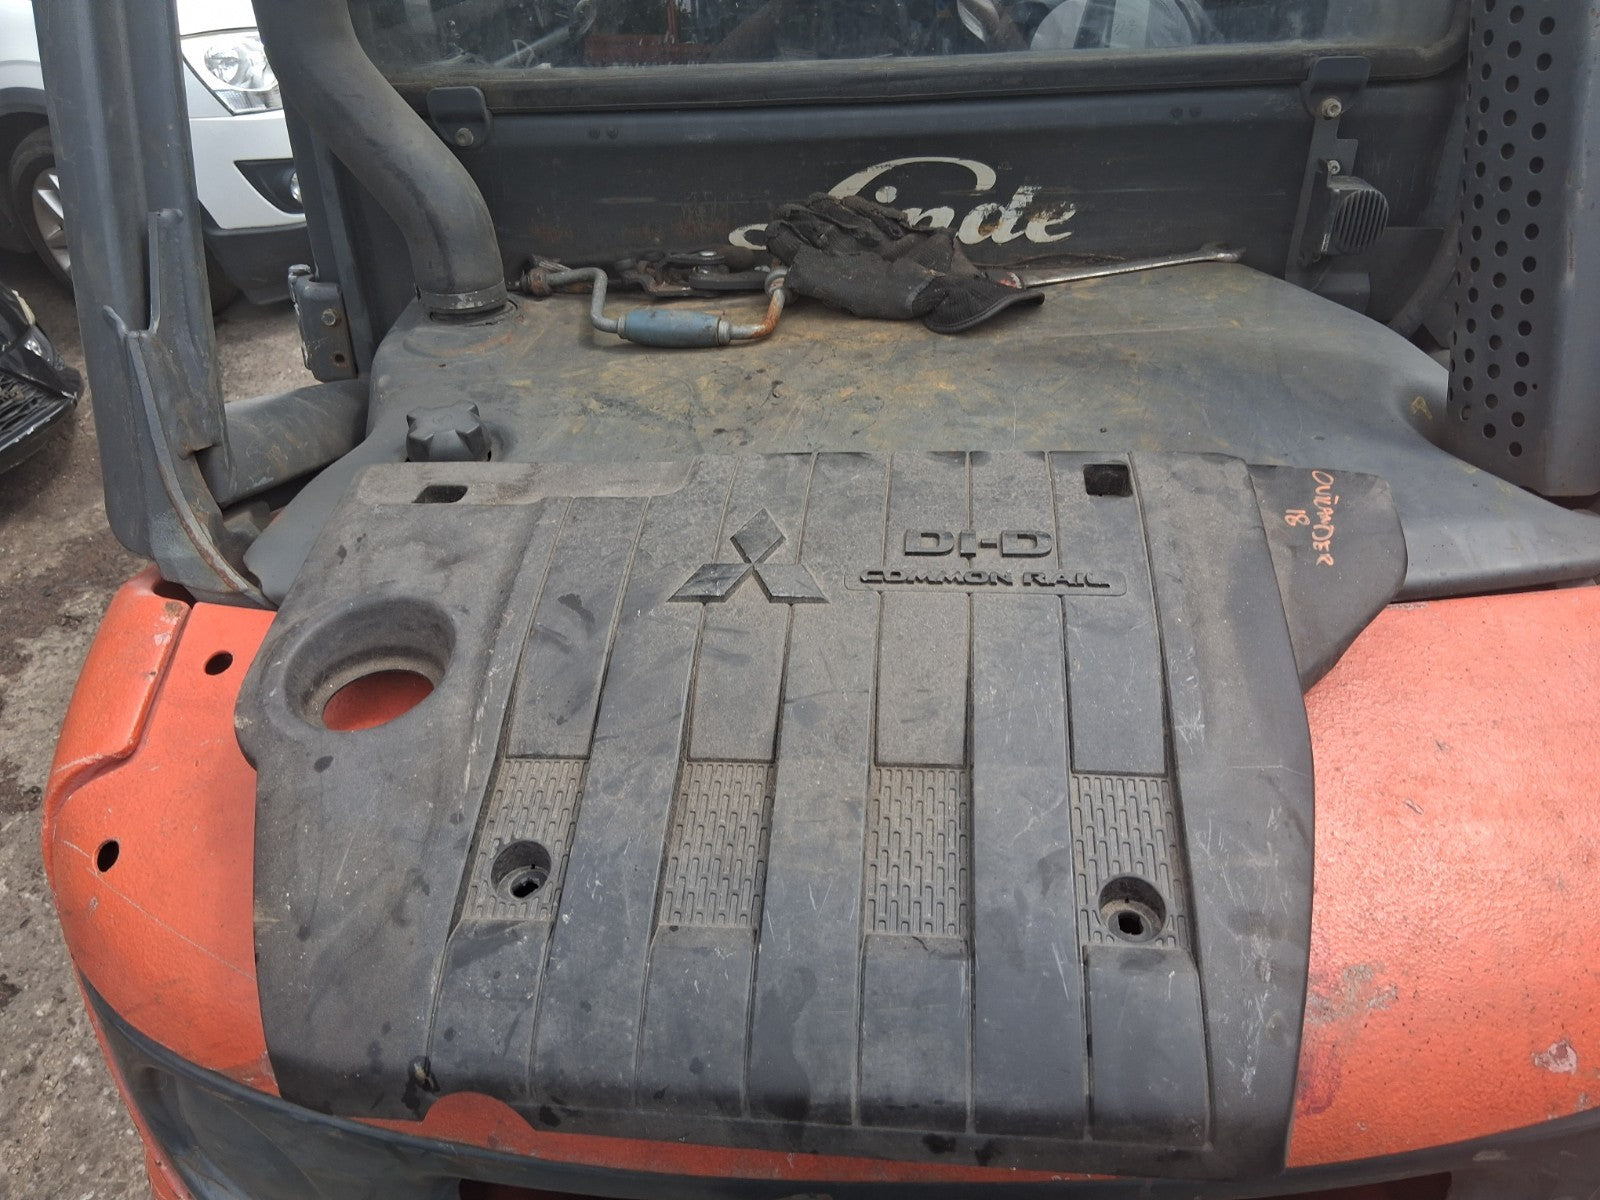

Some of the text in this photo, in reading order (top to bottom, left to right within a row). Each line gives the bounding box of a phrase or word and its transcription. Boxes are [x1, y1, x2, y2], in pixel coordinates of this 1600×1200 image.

[728, 156, 1077, 250] Lnde
[1285, 508, 1310, 527] 18
[904, 529, 1053, 558] DI-D
[859, 570, 1111, 588] COMMON RAIL
